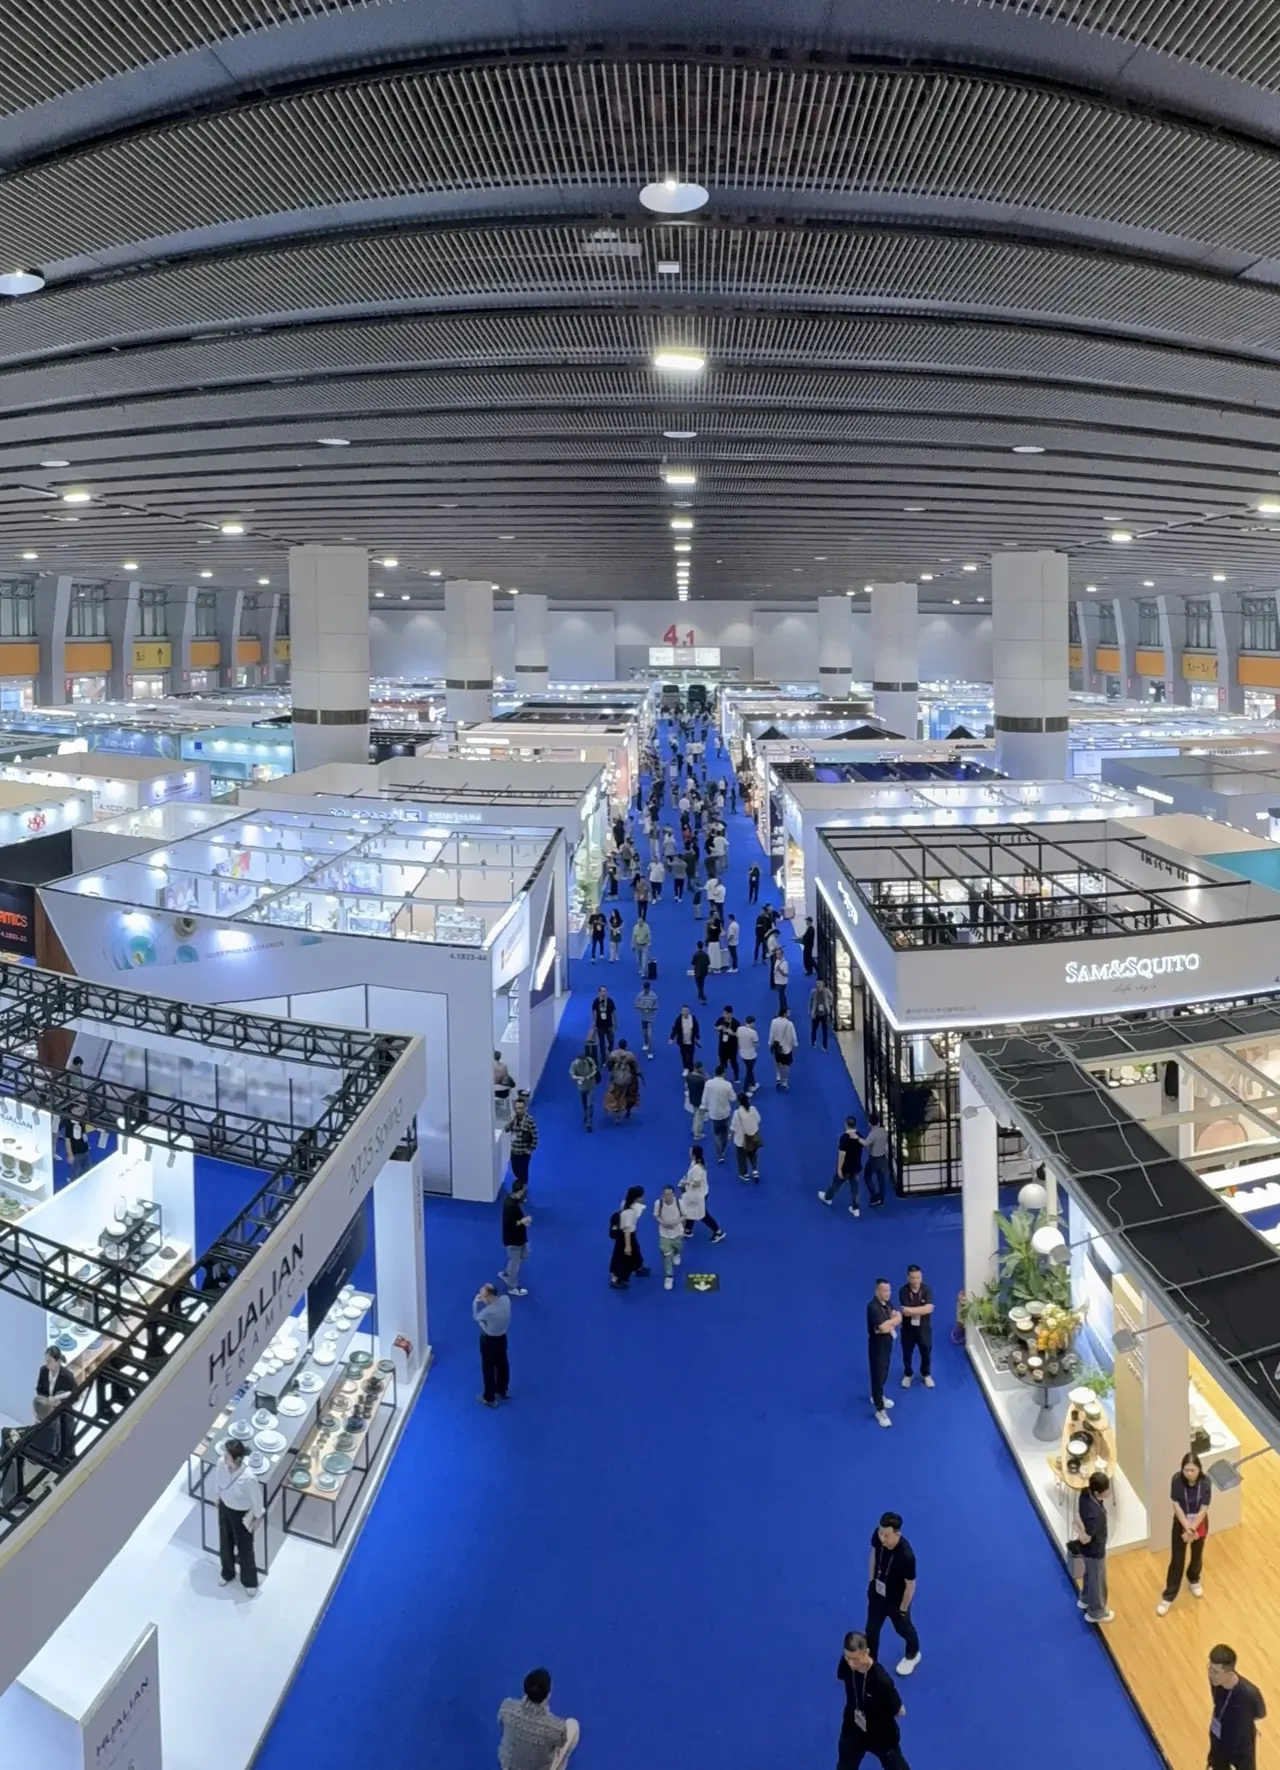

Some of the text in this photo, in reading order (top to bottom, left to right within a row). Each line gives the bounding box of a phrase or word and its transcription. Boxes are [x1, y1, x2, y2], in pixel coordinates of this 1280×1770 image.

[663, 624, 694, 646] 4.1
[374, 1096, 404, 1154] Spring
[207, 1232, 305, 1383] HUALIAN
[207, 1263, 306, 1409] CERAMICS
[96, 1675, 149, 1757] HUALIAN
